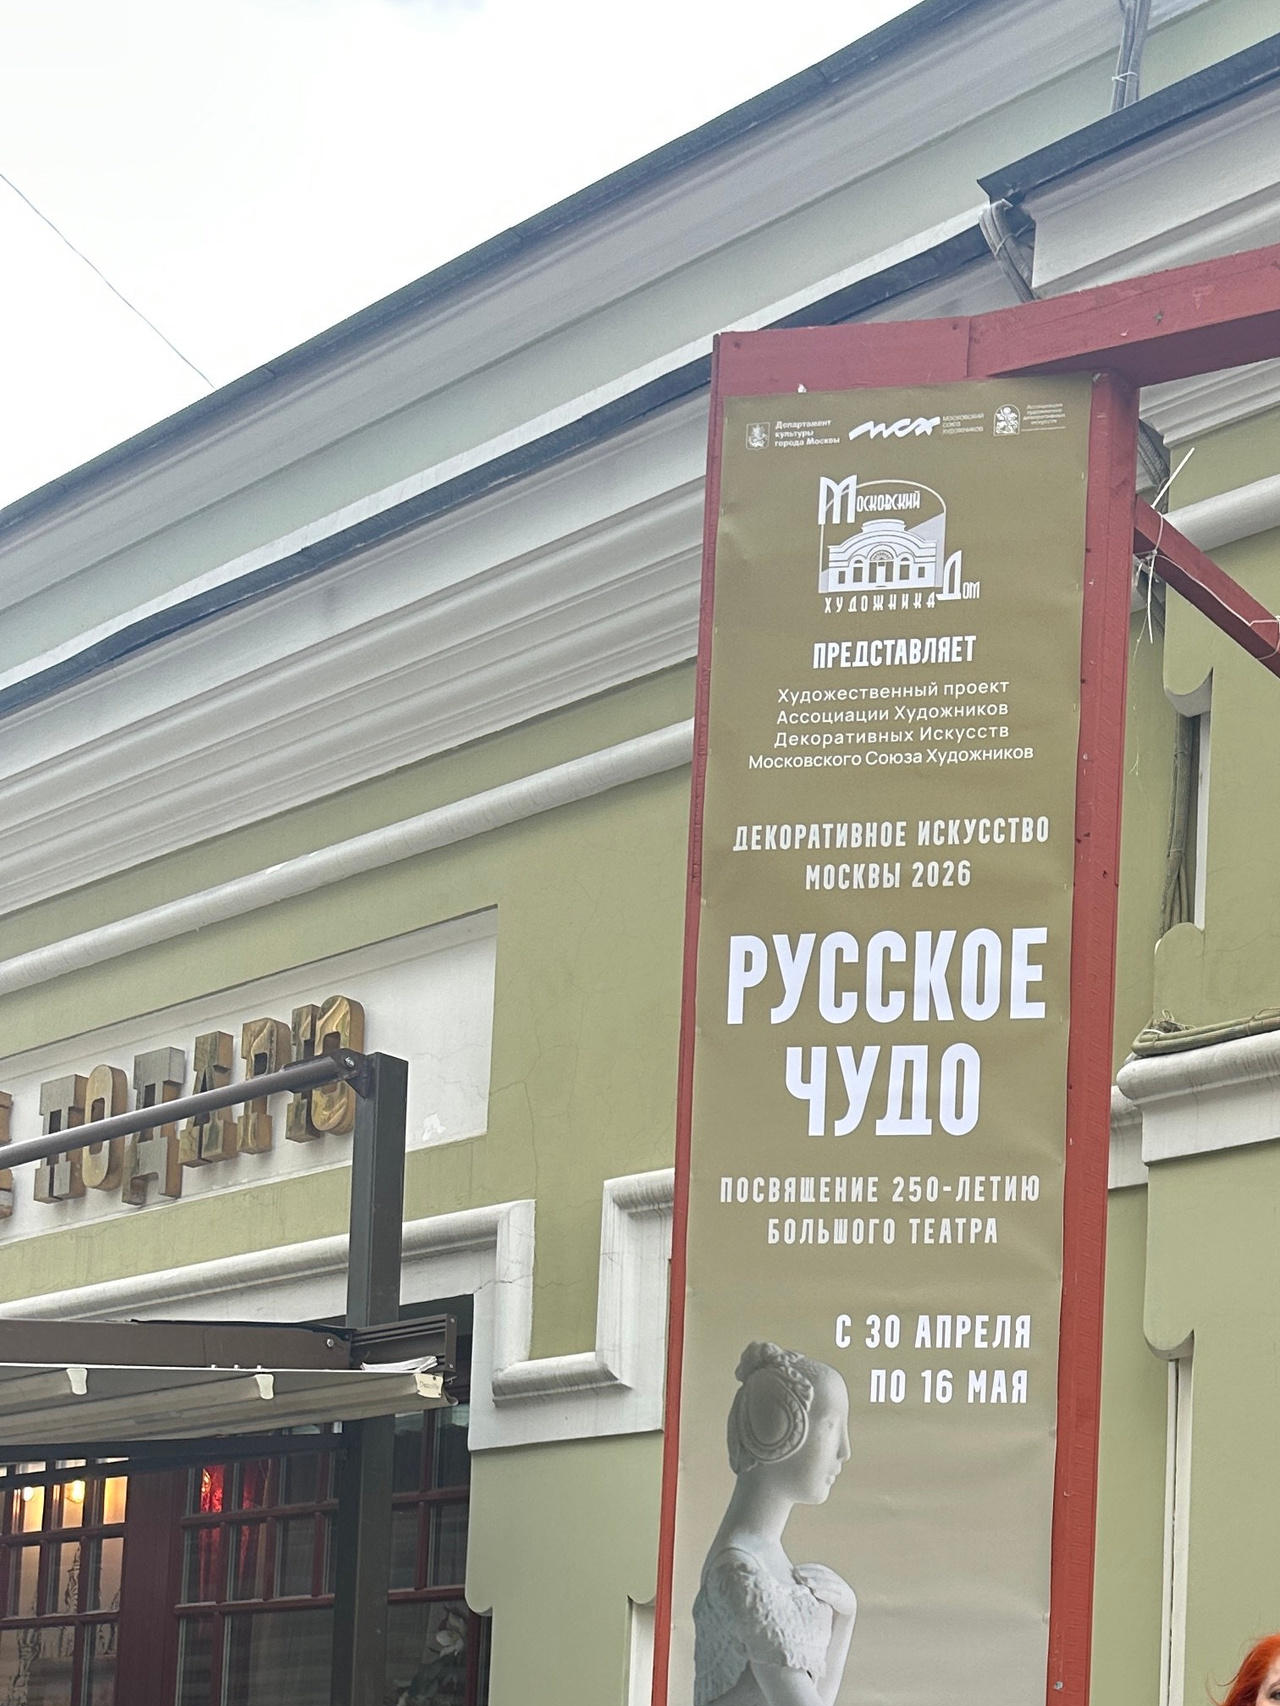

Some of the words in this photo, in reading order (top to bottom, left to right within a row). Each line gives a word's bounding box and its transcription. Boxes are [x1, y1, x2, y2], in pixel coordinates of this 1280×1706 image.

[824, 591, 936, 614] ХУДОЖНИКА
[813, 635, 976, 668] ПРЕДСТАВЛЯЕТ
[777, 682, 938, 704] Художественный
[944, 679, 1009, 699] проект
[777, 706, 889, 725] Ассоциации
[894, 701, 1008, 721] Художников
[774, 728, 913, 748] Декоративных
[920, 724, 1008, 744] Искусств
[749, 750, 861, 770] Московского
[865, 749, 922, 765] Союза
[926, 746, 1033, 764] Художников
[733, 820, 906, 852] ДЕКОРАТИВНОЕ
[918, 816, 1050, 846] ИСКУССТВО
[805, 862, 901, 890] МОСКВЫ
[912, 860, 971, 888] 2026
[727, 927, 1049, 1025] РУССКОЕ
[785, 1043, 982, 1137] ЧУДО
[720, 1176, 879, 1204] ПОСВЯЩЕНИЕ
[892, 1175, 1041, 1203] 250-ЛЕТИЮ
[767, 1218, 896, 1245] БОЛЬШОГО
[910, 1217, 998, 1244] ТЕАТРА
[835, 1314, 852, 1349] С
[865, 1314, 903, 1349] 30
[915, 1313, 1031, 1349] АПРЕЛЯ
[870, 1370, 907, 1404] ПО
[921, 1370, 954, 1403] 16
[967, 1370, 1028, 1404] МАЯ
